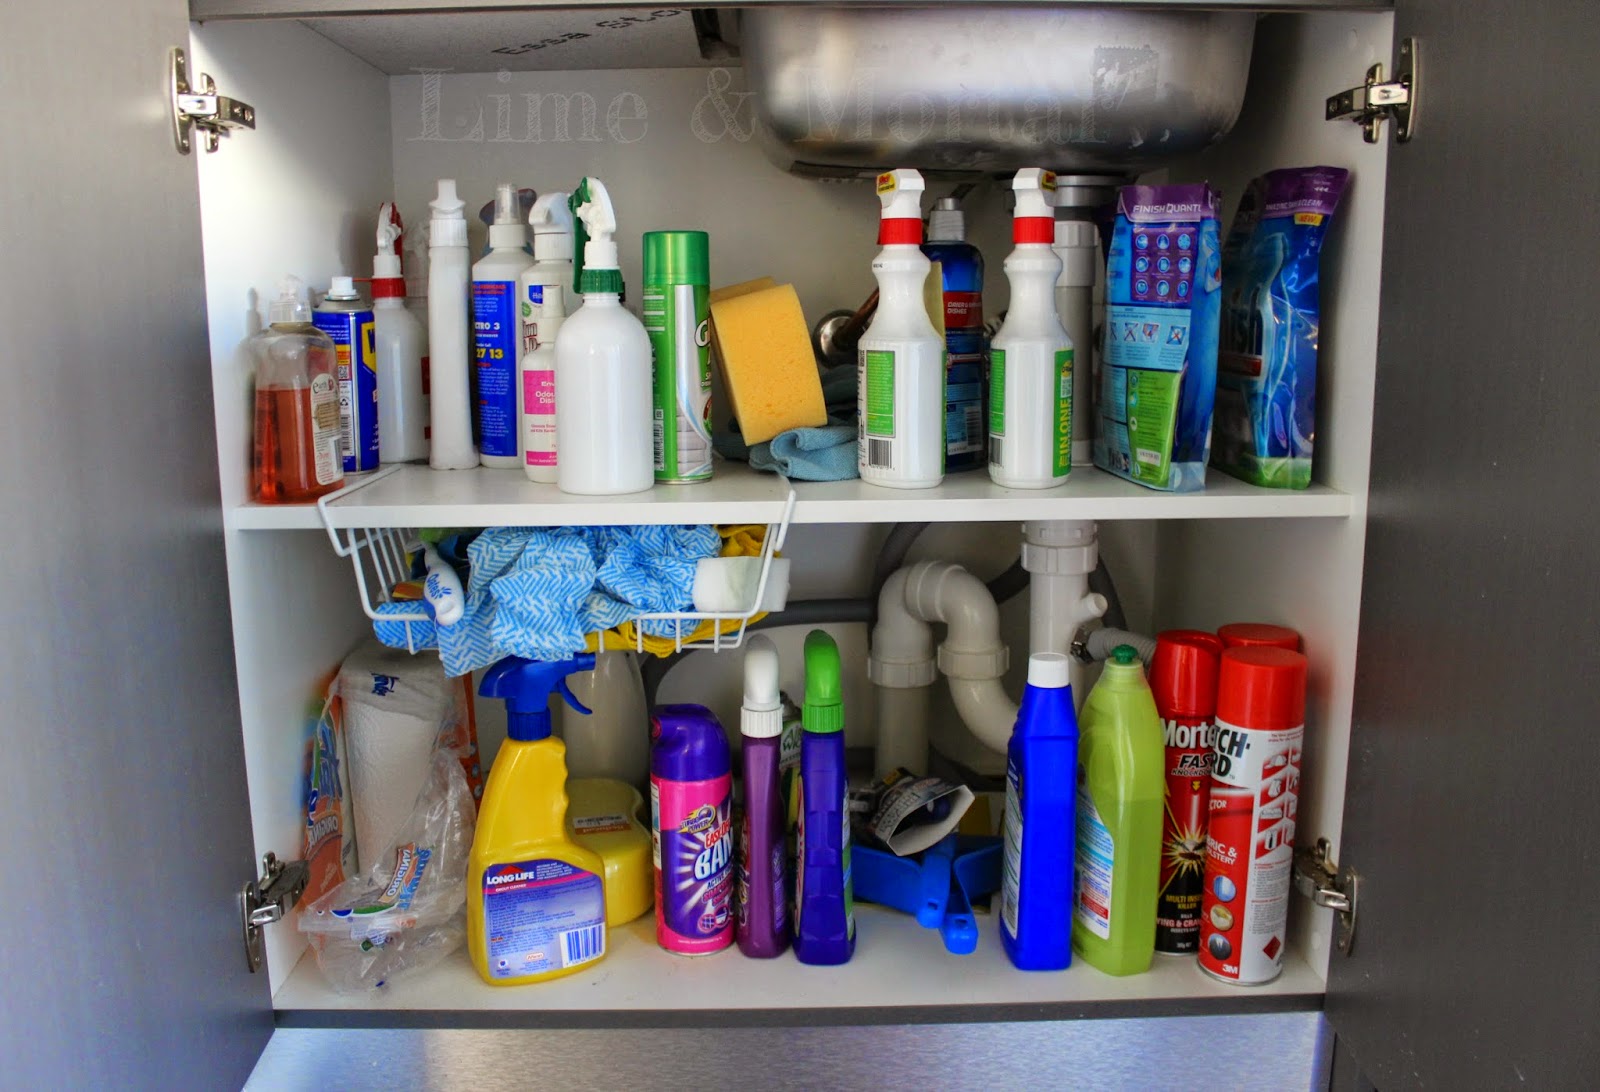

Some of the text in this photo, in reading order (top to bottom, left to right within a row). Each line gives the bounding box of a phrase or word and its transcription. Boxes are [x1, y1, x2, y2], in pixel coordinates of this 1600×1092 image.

[491, 8, 693, 55] Essa Sto
[1133, 204, 1166, 213] FINISH
[1302, 199, 1323, 207] CLEAN
[494, 322, 500, 330] 3
[489, 348, 504, 359] 13
[427, 573, 440, 600] Oates
[1178, 753, 1213, 768] FAS
[1228, 846, 1238, 859] &
[487, 873, 514, 885] LONG
[515, 871, 535, 881] LIFE
[1166, 894, 1187, 903] MULTI
[1222, 964, 1239, 975] 3M
